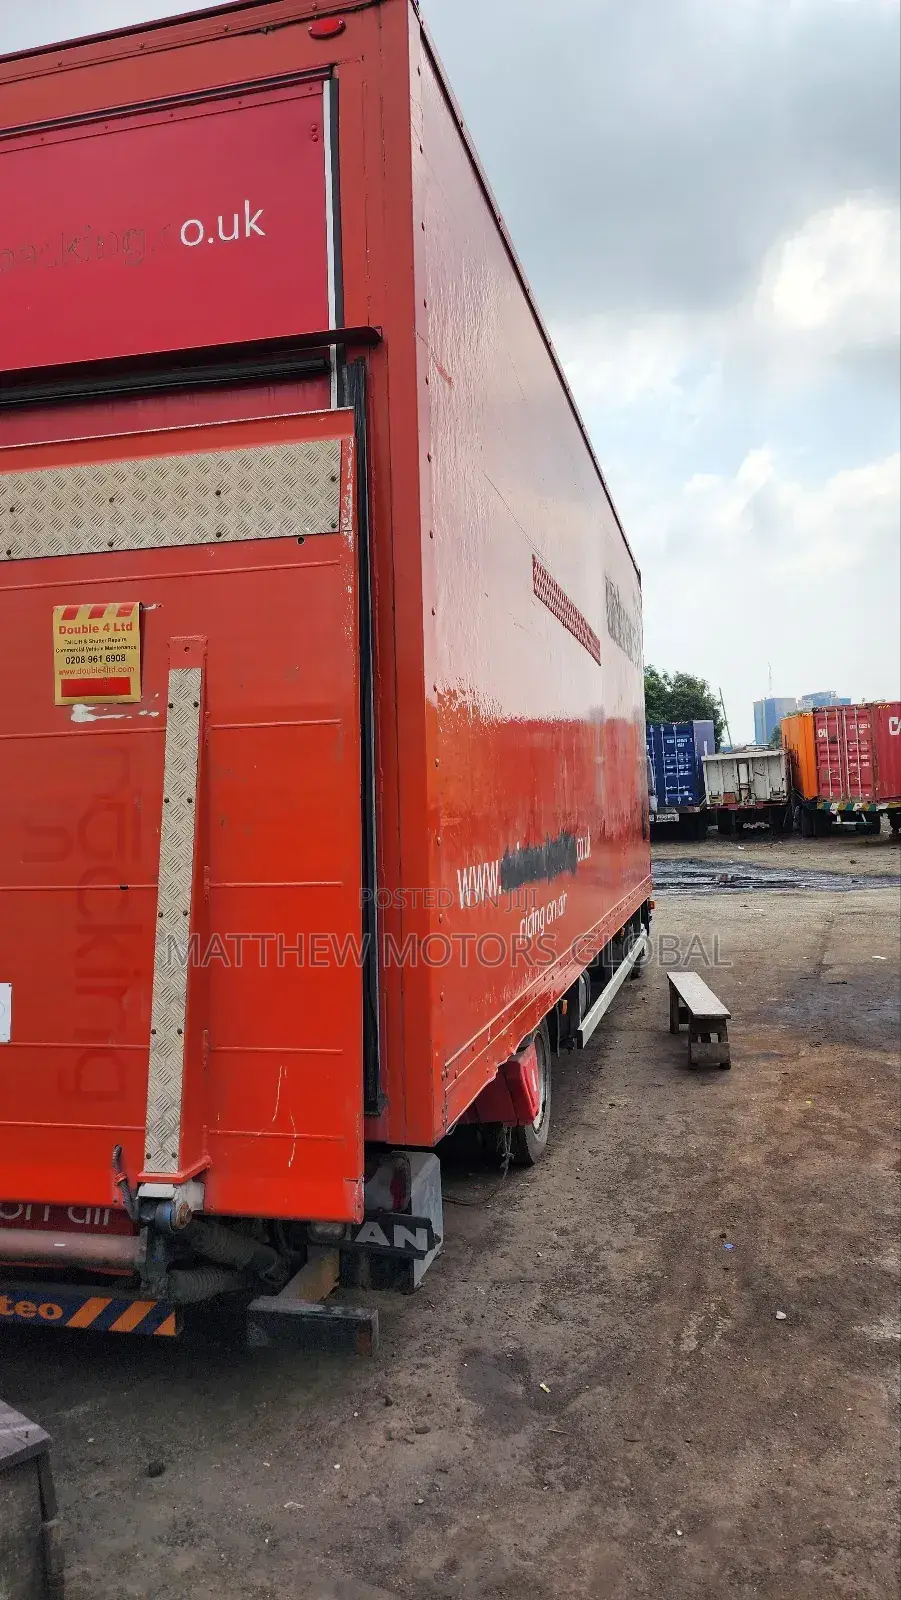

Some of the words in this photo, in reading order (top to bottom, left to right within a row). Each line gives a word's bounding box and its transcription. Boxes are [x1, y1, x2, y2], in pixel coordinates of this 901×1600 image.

[58, 623, 100, 635] Double
[103, 622, 111, 633] 4
[113, 621, 134, 633] Ltd
[55, 646, 85, 654] Commercial
[65, 655, 86, 665] 0208
[87, 654, 103, 664] 961
[105, 653, 126, 663] 6908
[58, 666, 135, 676] www.double4ltd.com
[519, 907, 545, 945] riding
[546, 899, 557, 925] on
[344, 1221, 429, 1252] AN
